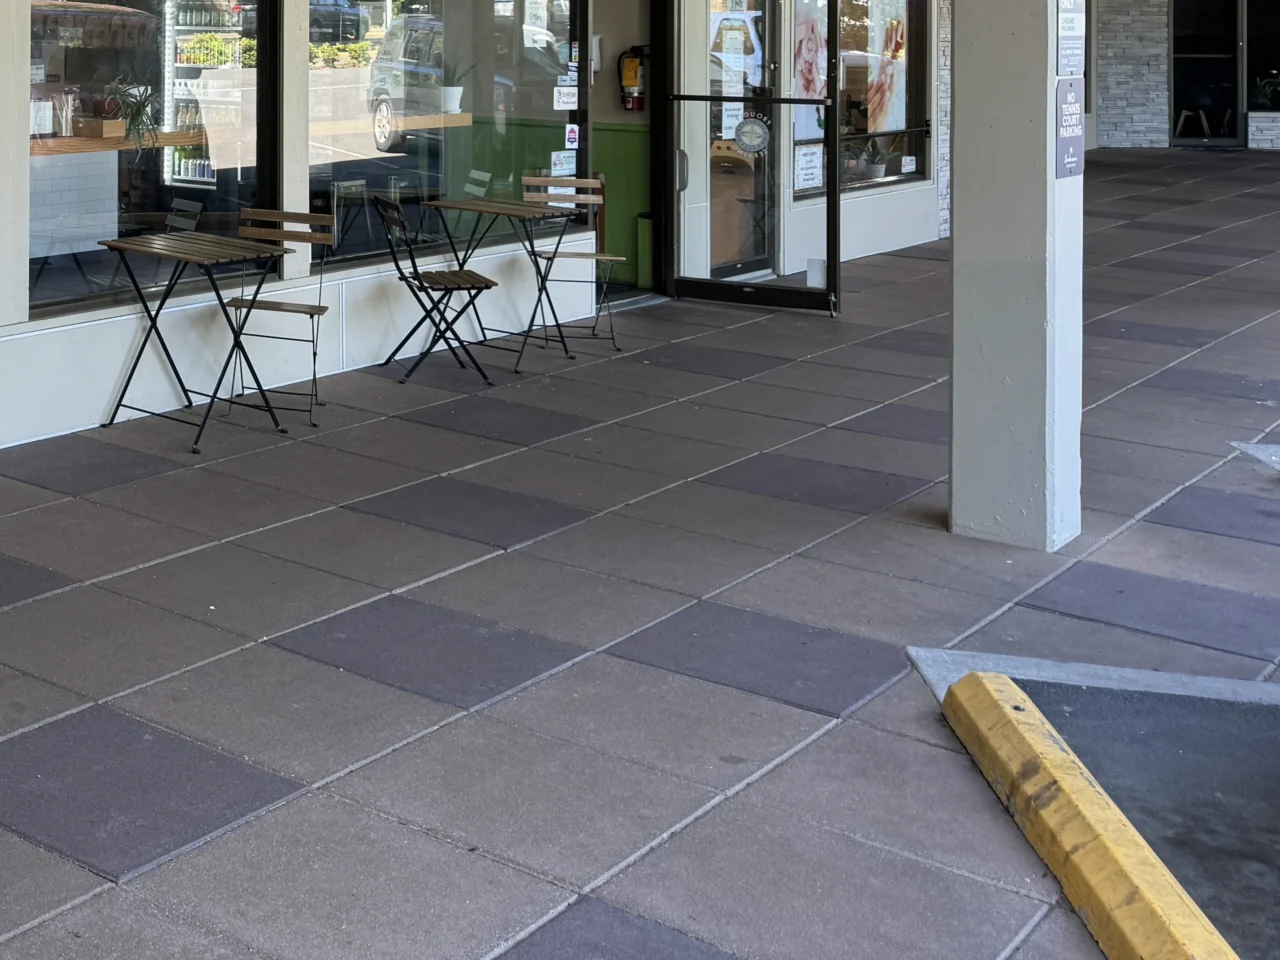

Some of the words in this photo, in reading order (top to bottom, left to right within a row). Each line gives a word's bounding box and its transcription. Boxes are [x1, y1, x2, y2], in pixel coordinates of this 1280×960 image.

[1067, 92, 1075, 103] NO
[1062, 103, 1081, 115] TENNIS
[1062, 114, 1080, 127] COURT
[1060, 125, 1082, 138] PARKING
